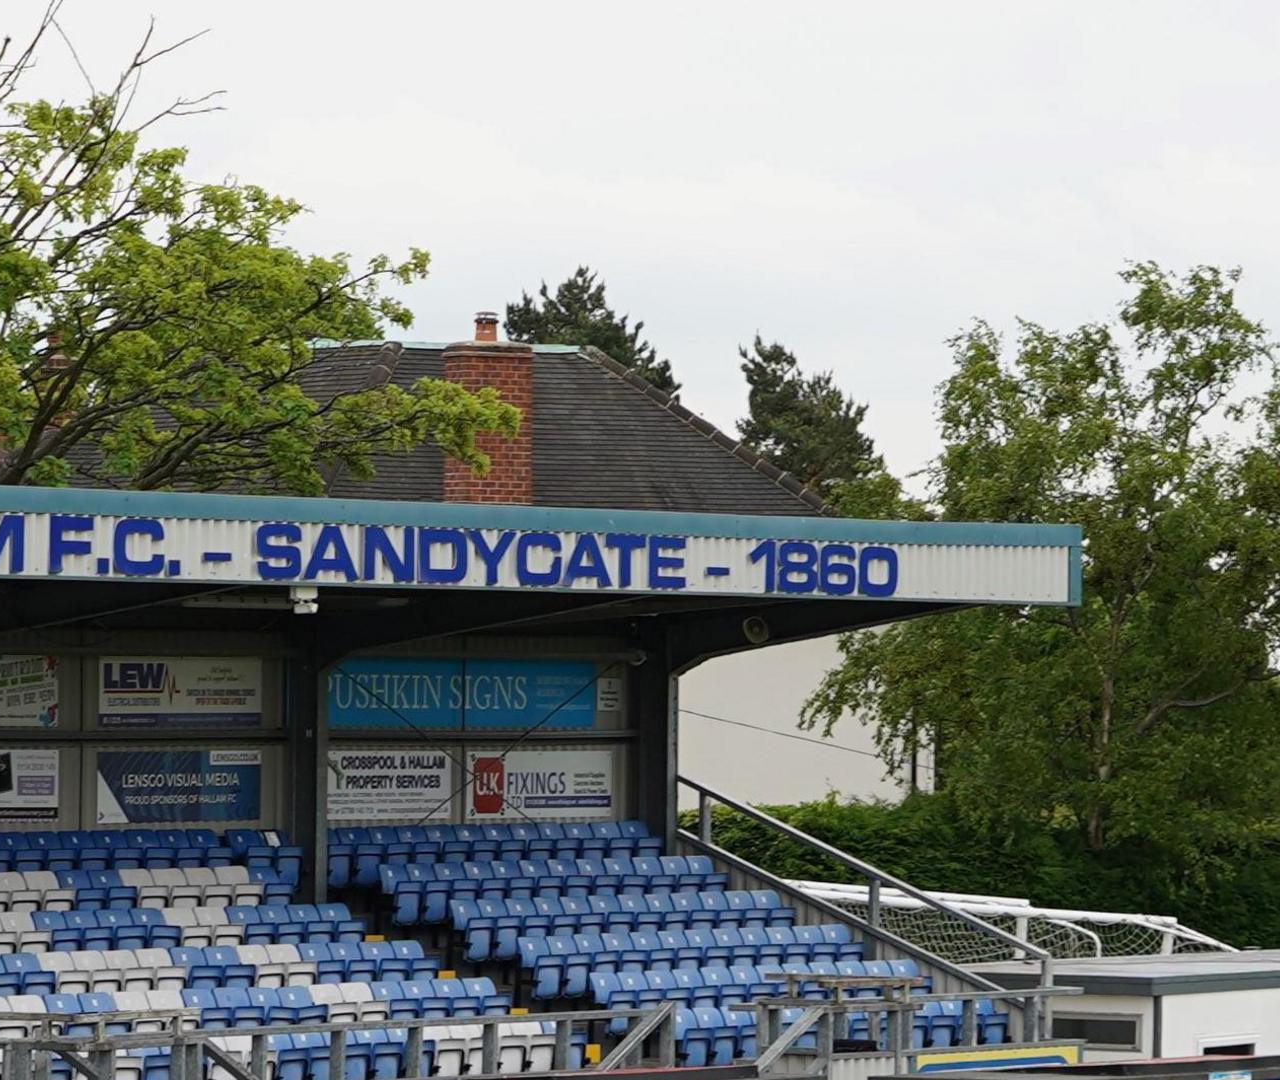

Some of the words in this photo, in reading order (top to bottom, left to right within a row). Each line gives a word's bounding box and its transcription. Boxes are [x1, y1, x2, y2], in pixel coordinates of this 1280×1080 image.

[50, 515, 180, 577] F.C.
[749, 540, 898, 598] 1860
[104, 663, 165, 689] LEW
[449, 674, 528, 711] SIGNS
[340, 756, 398, 770] CROSSPOOL
[399, 756, 407, 769] &
[408, 756, 446, 769] HALLAM
[166, 773, 203, 787] VISUAL
[205, 772, 240, 787] MEDIA
[345, 775, 394, 789] PROPERTY
[395, 775, 441, 789] SERVICES
[506, 771, 567, 795] FIXINGS
